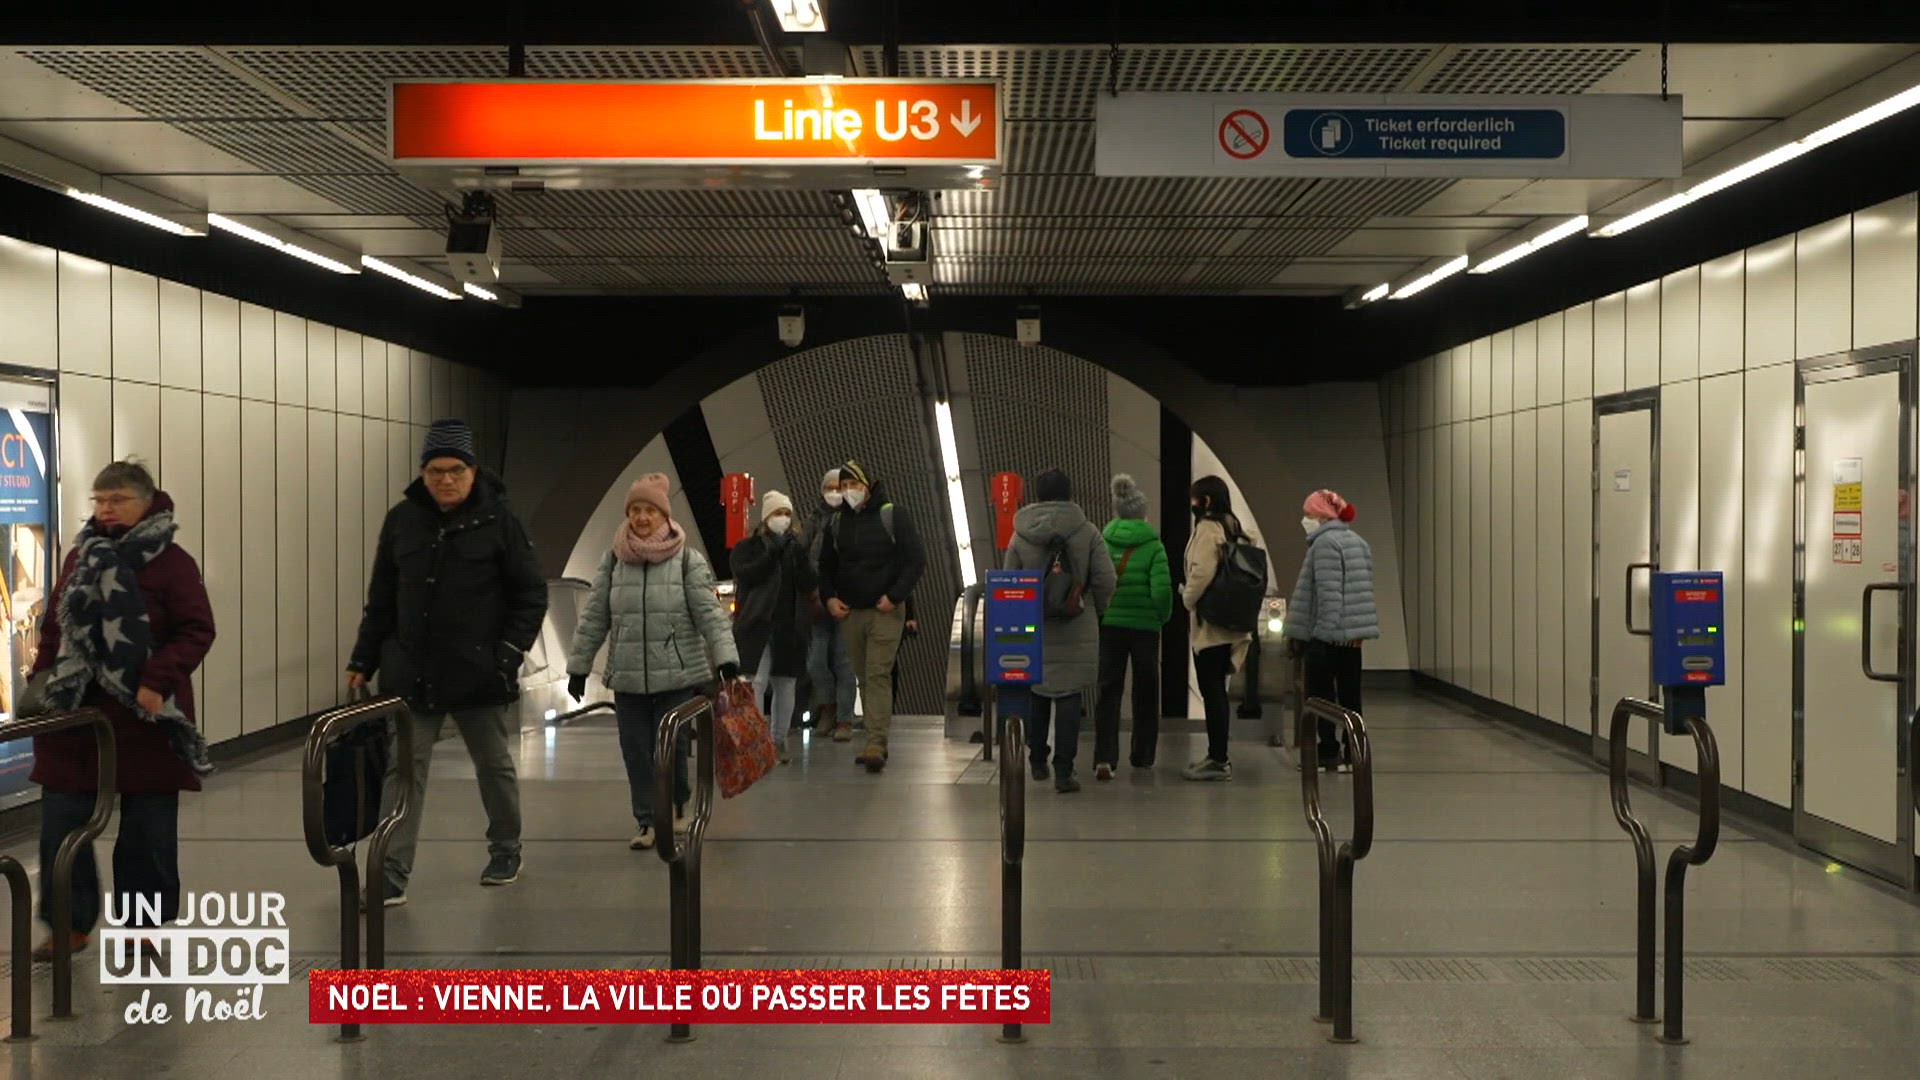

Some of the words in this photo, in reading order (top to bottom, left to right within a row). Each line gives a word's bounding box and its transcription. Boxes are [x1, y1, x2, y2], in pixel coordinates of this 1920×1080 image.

[754, 99, 863, 141] Linie
[875, 99, 939, 141] U3
[1365, 118, 1412, 132] Ticket
[1416, 117, 1515, 132] erforderlich
[1378, 135, 1427, 150] Ticket
[1430, 135, 1502, 153] required
